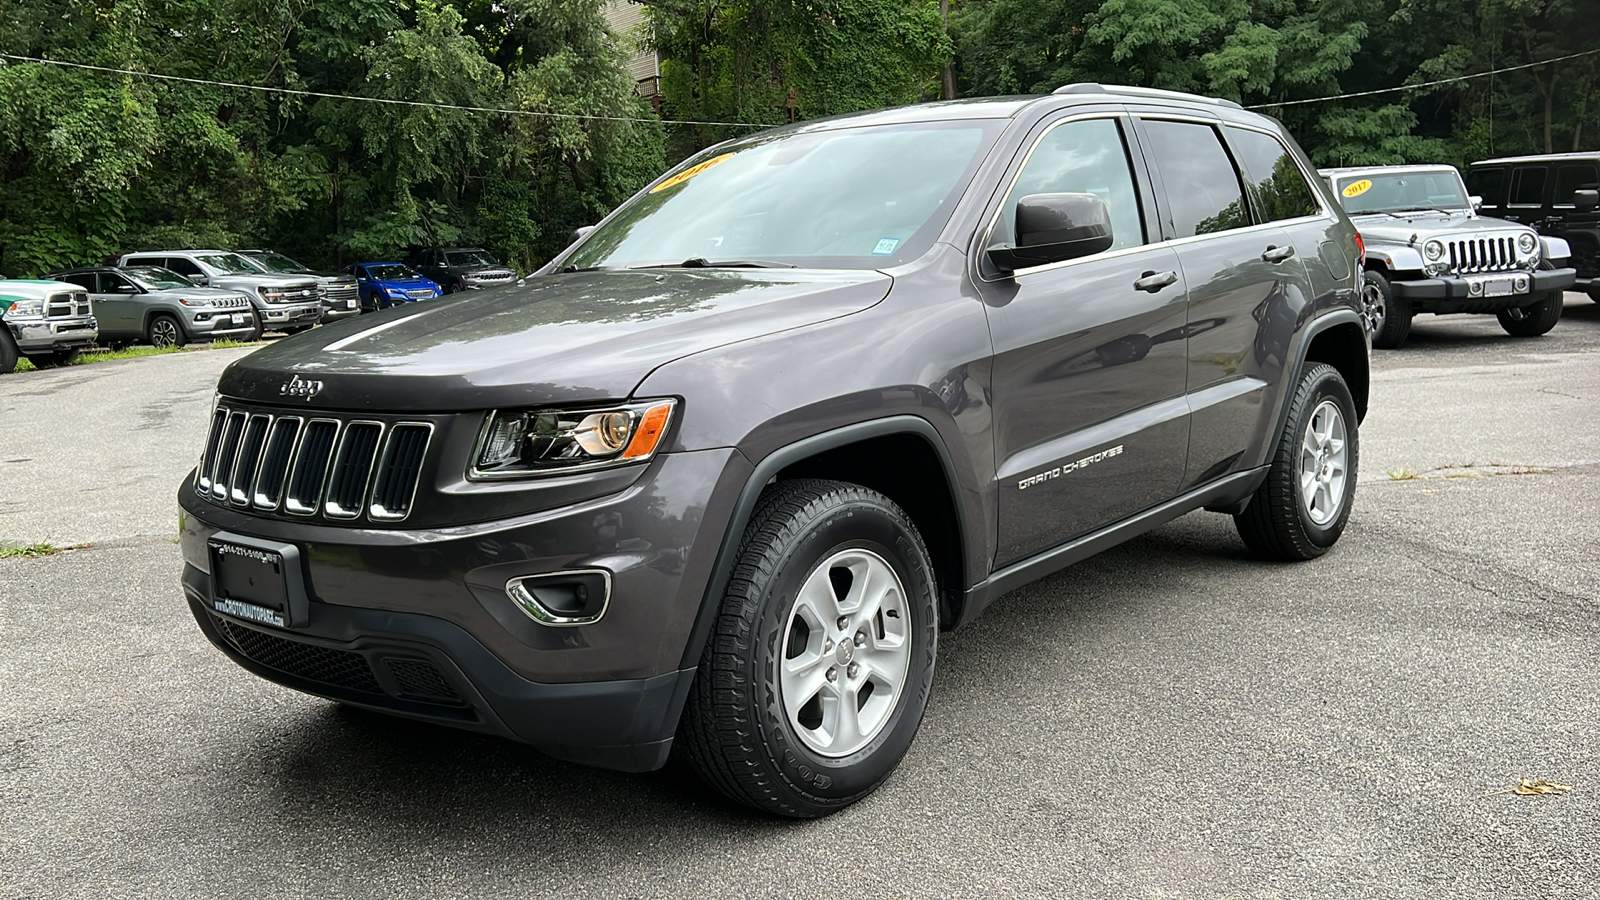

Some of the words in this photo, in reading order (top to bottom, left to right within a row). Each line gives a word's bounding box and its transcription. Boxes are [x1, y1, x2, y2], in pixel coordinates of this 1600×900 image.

[1346, 181, 1367, 196] 2017
[279, 373, 324, 402] Jeep
[1017, 467, 1061, 490] GRAND
[1062, 444, 1125, 474] CHEROKEE
[222, 544, 263, 560] 914-271-5100
